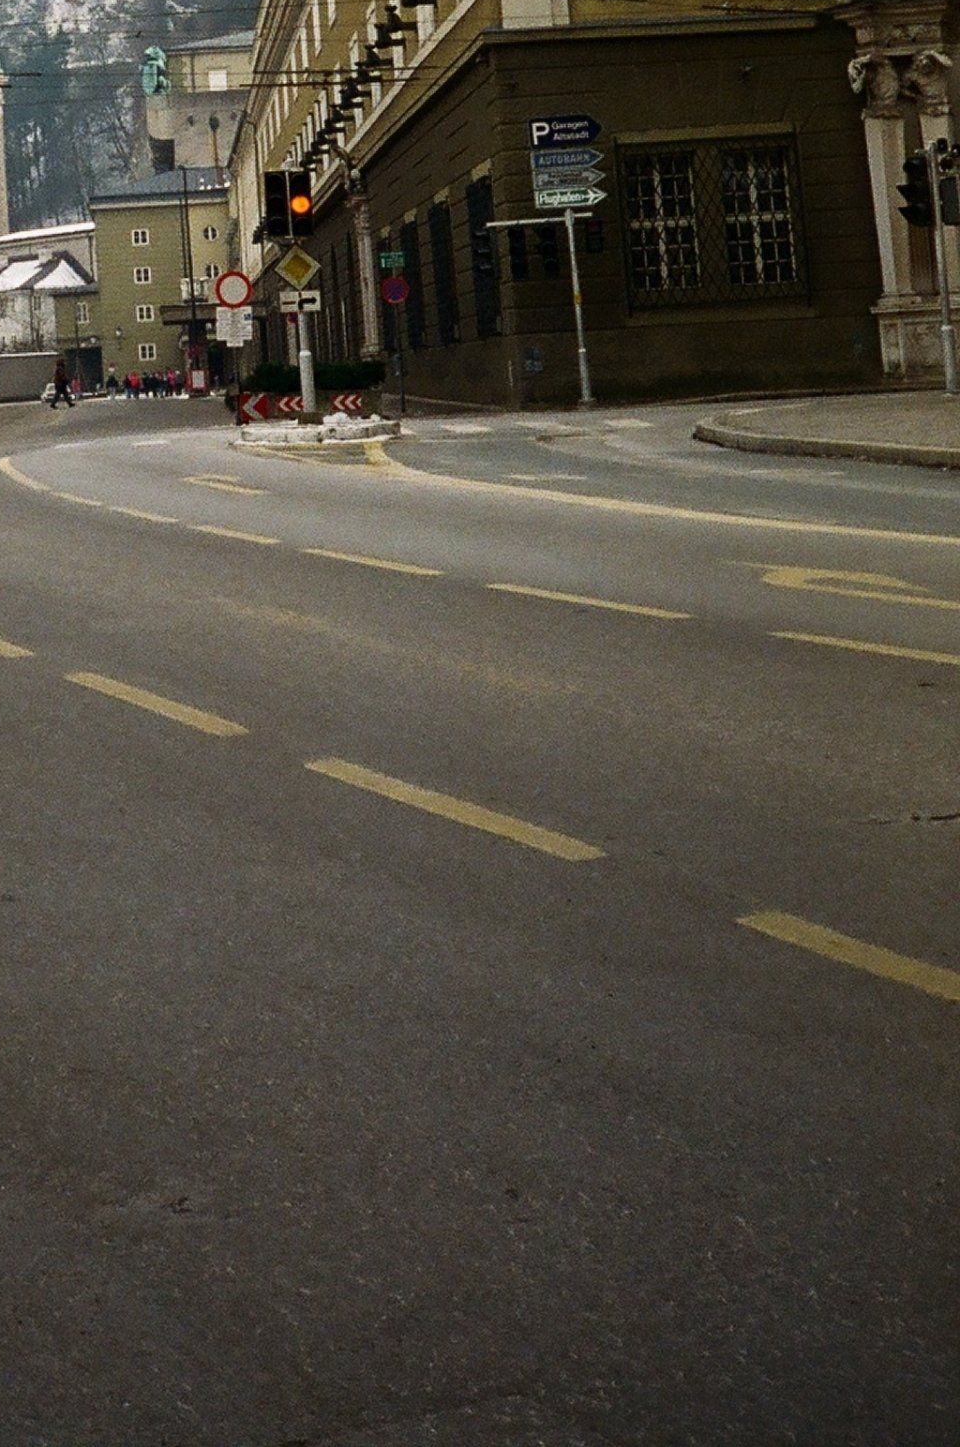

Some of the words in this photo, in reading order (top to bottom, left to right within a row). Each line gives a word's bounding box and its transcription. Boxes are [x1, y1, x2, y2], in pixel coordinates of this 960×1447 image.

[531, 122, 550, 146] P
[538, 152, 591, 165] AUTOBAHN
[539, 192, 583, 206] Flughafen
